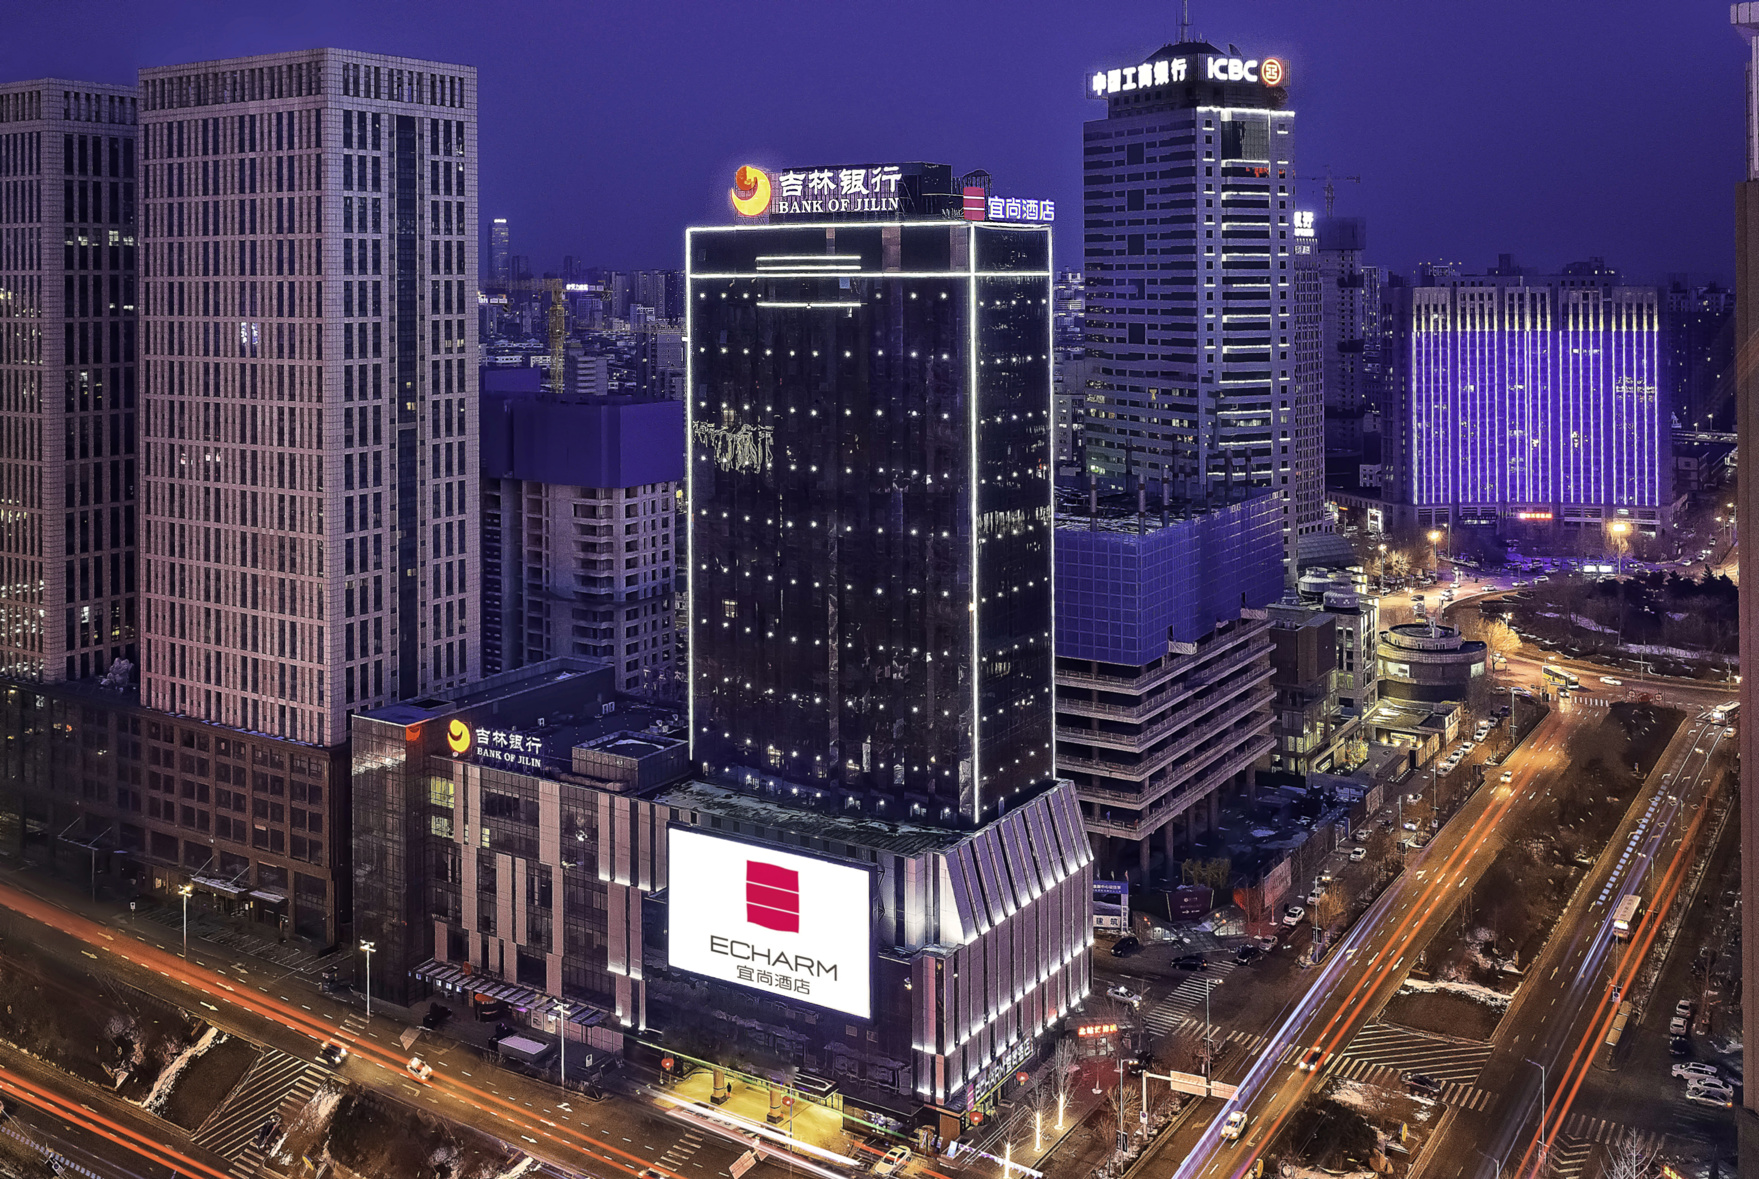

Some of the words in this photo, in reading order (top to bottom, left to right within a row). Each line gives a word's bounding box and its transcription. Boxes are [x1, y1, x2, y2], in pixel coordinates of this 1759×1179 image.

[1207, 57, 1258, 82] ICBC
[779, 166, 902, 197] 吉林银行
[779, 199, 824, 215] BANK
[828, 199, 850, 212] OF
[854, 197, 900, 212] JILIN
[987, 195, 1055, 222] 宜尚酒店
[475, 728, 542, 754] 吉林银行
[477, 747, 502, 760] BANK
[504, 752, 516, 762] OF
[518, 755, 542, 768] JILIN
[710, 934, 838, 982] ECHARM
[736, 965, 811, 995] 宜尚酒店
[975, 1057, 1006, 1102] ECHARM
